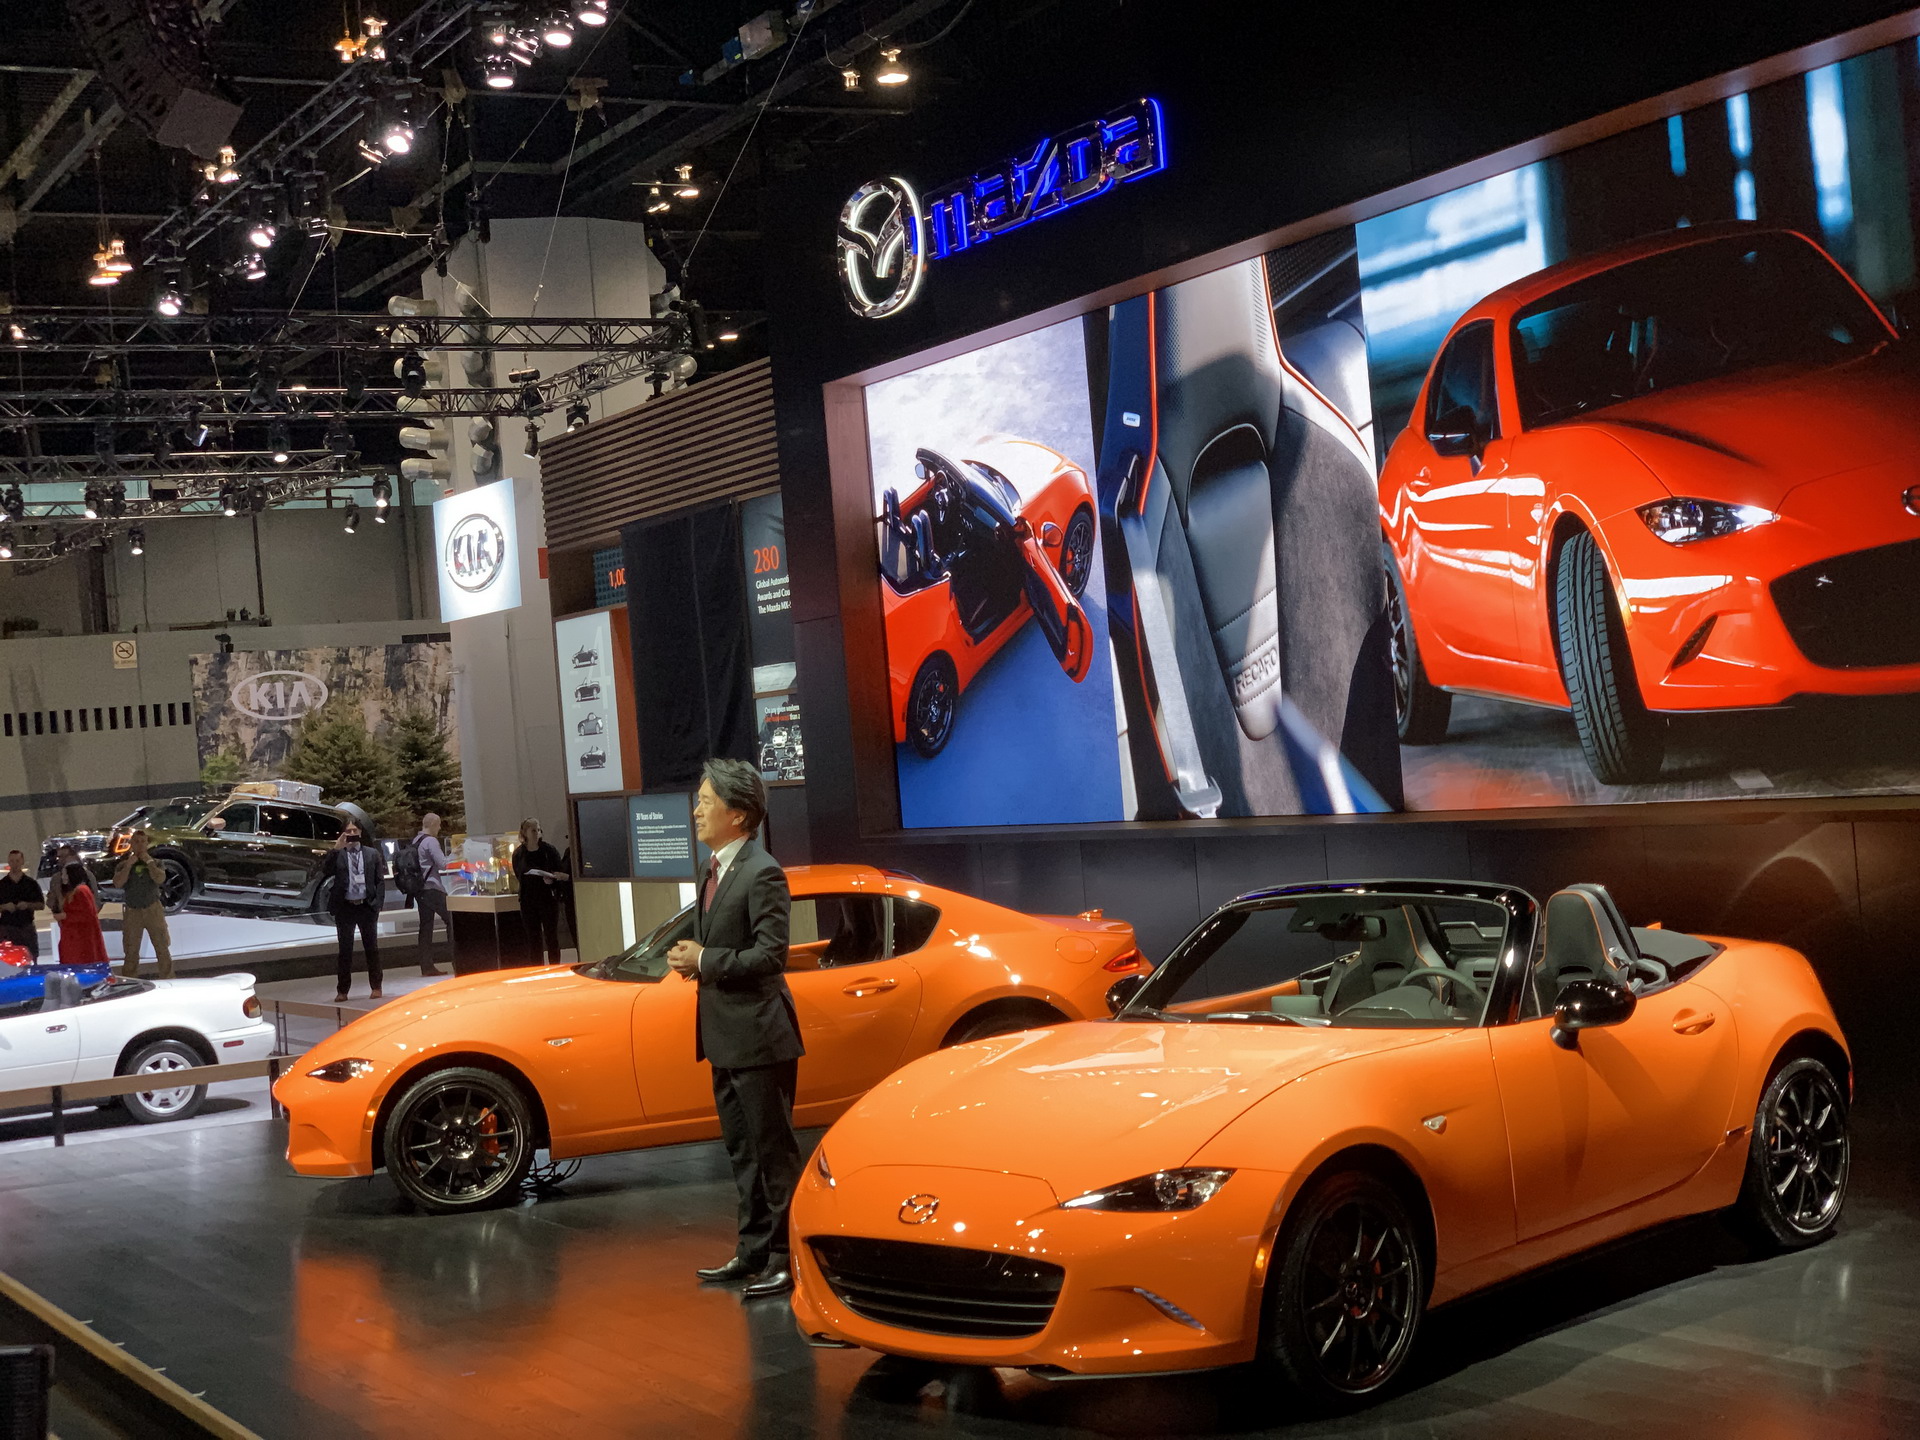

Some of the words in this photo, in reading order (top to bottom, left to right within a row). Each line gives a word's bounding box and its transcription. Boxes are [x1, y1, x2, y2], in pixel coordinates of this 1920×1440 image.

[453, 529, 494, 575] KIA
[753, 545, 780, 574] 280
[756, 580, 769, 589] Global
[757, 591, 772, 601] Awards
[773, 590, 781, 598] and
[758, 605, 766, 614] The
[767, 604, 780, 612] Mazda
[1235, 647, 1278, 695] RECARO
[249, 681, 312, 710] KIA
